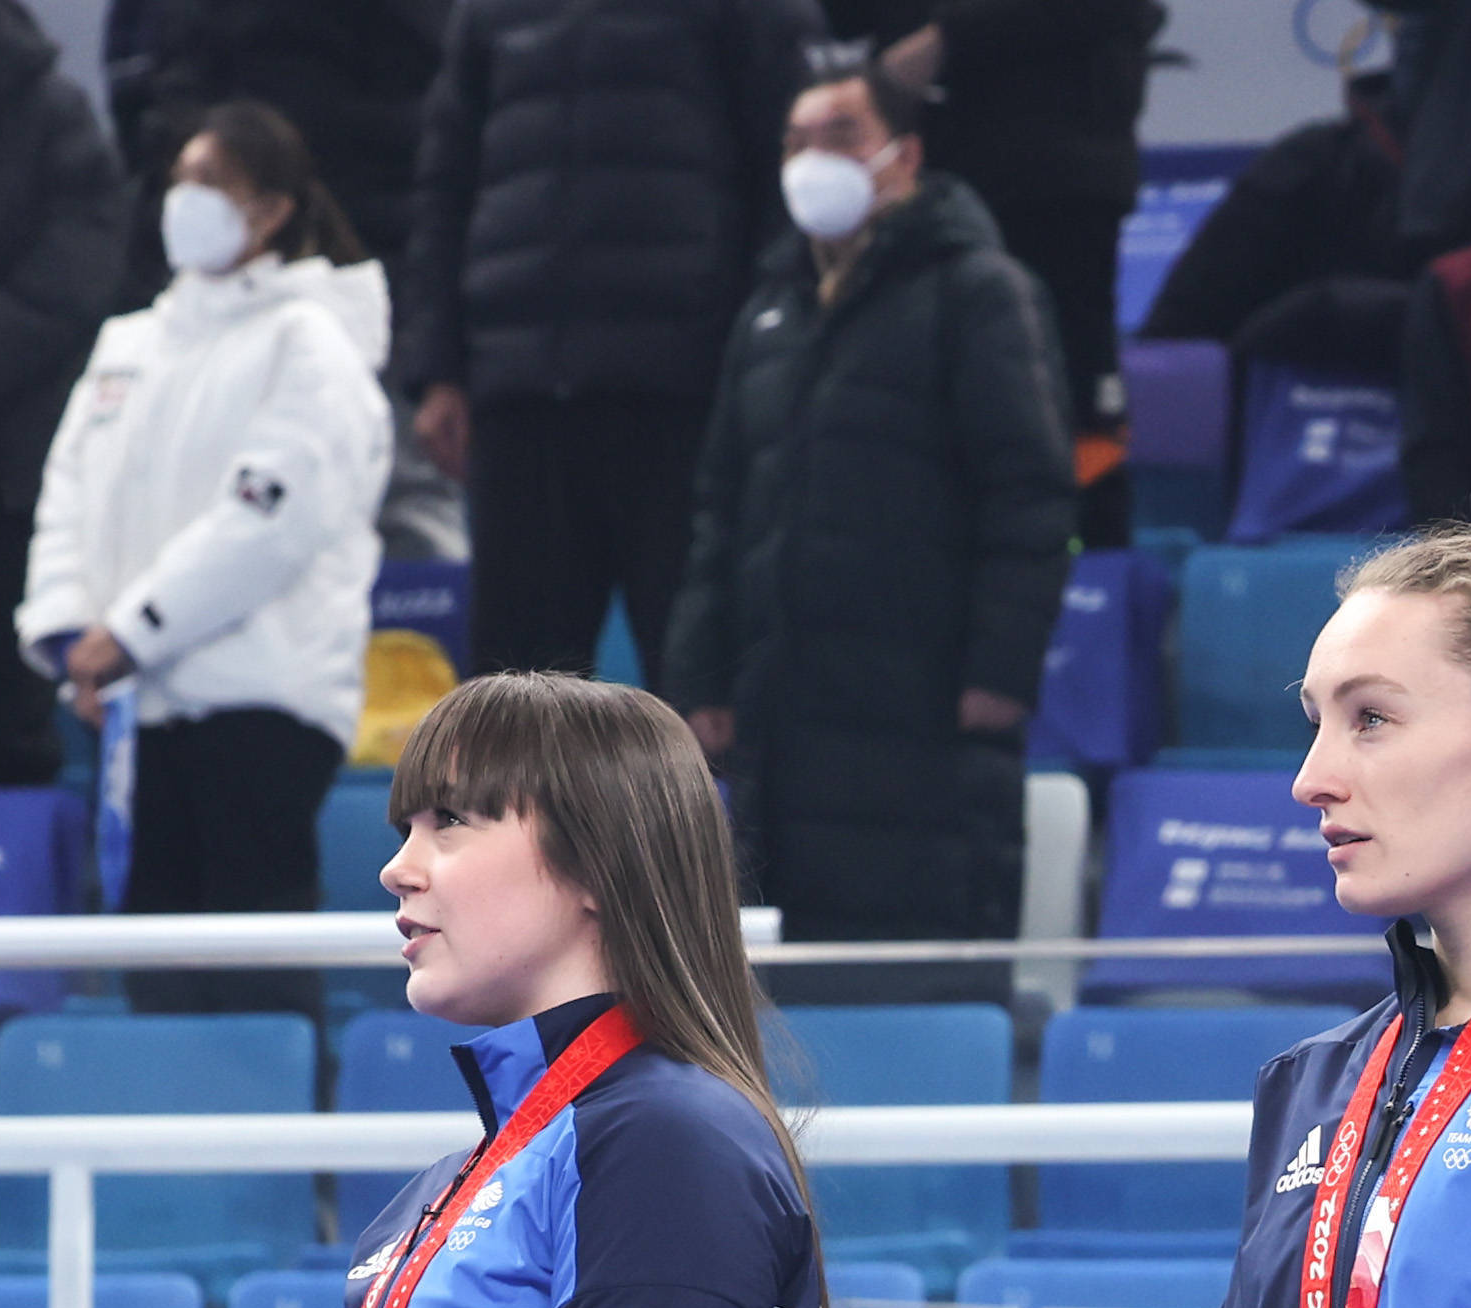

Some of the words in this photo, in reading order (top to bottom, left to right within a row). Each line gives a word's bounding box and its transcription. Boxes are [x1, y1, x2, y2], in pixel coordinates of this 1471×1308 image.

[1445, 1132, 1471, 1145] TEAM
[1276, 1163, 1326, 1193] adidas
[1309, 1189, 1338, 1281] 2022
